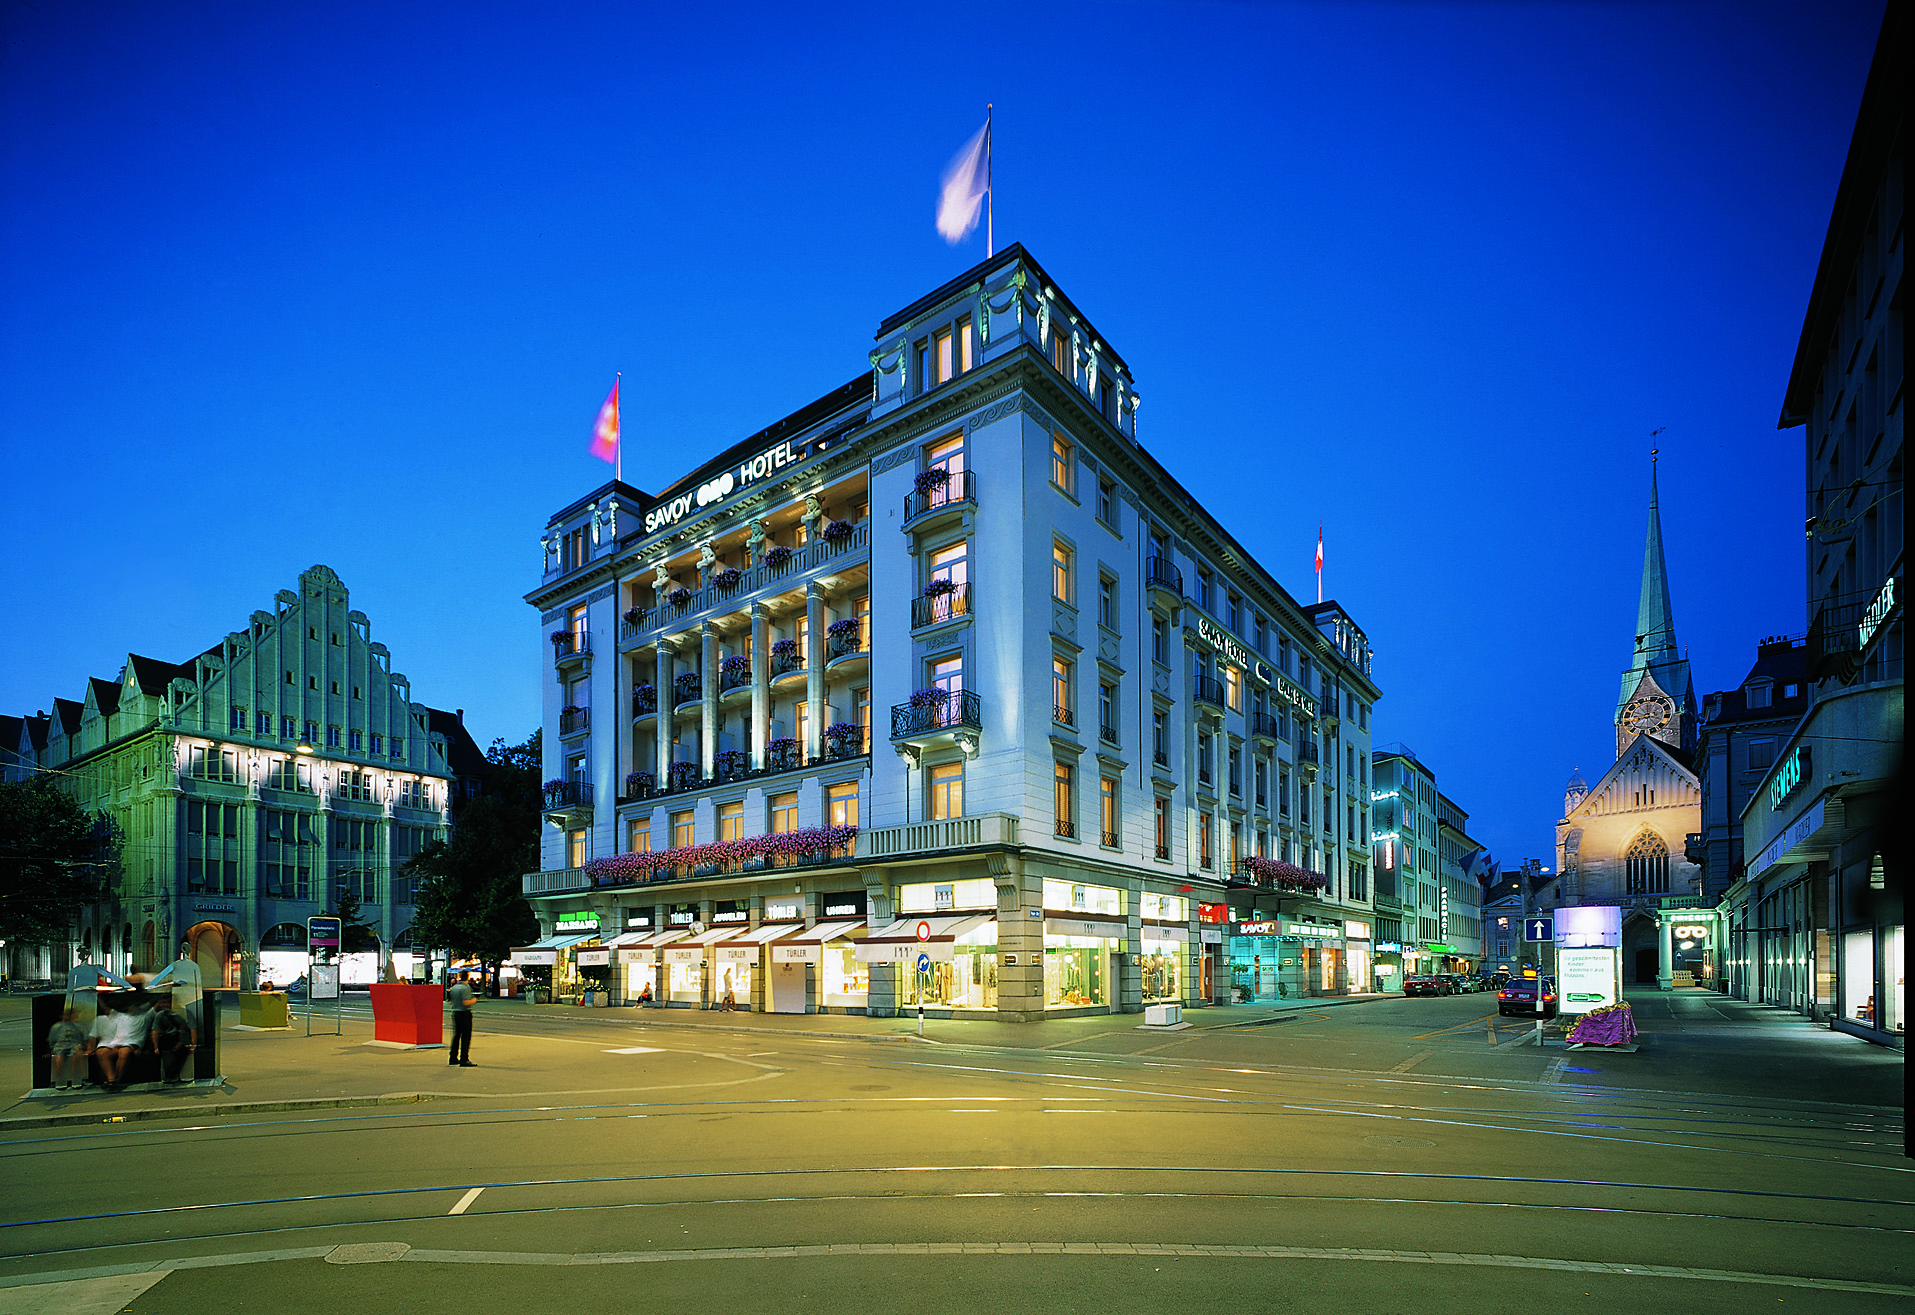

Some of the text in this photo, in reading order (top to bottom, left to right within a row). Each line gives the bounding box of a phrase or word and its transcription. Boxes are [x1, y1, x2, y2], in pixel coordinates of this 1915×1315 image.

[645, 441, 797, 533] SAVOY HOTEL
[1858, 577, 1895, 651] MÄDLER
[1771, 746, 1801, 812] SIEMENS
[768, 905, 797, 919] TÜRLER
[826, 905, 856, 916] UHREN
[670, 912, 693, 924] TÜRLER
[556, 920, 598, 930] MARSANO
[1240, 923, 1270, 933] SAVOY
[728, 950, 746, 958] TÜRLER
[786, 949, 807, 957] TÜRLER
